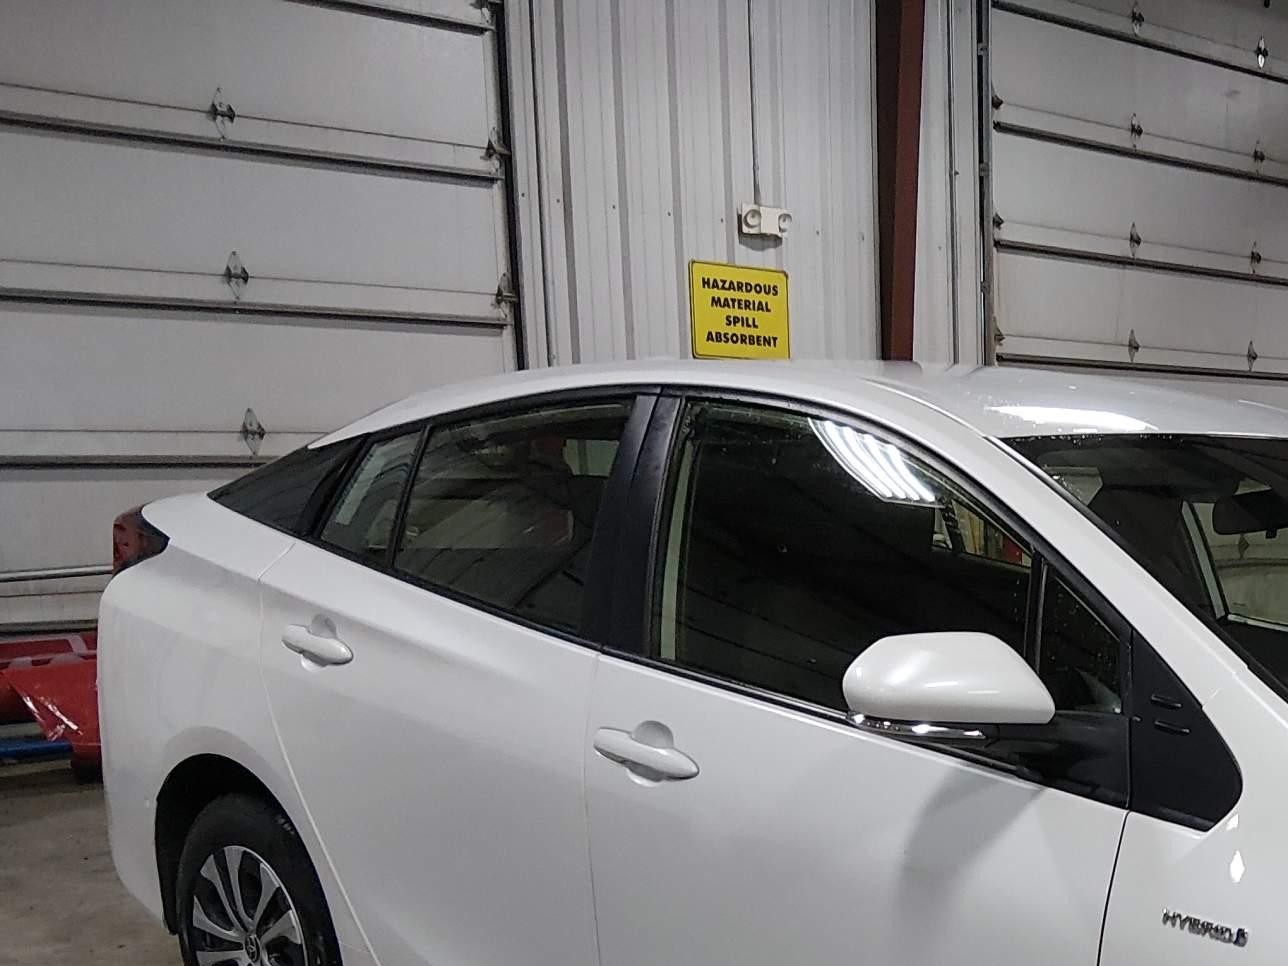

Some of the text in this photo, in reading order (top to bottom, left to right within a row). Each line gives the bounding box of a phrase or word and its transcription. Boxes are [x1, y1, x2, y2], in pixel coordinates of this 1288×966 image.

[702, 277, 778, 296] HAZARDOUS
[711, 296, 771, 313] MATERIAL
[725, 315, 759, 329] SPILL
[706, 331, 778, 348] ABSORBENT
